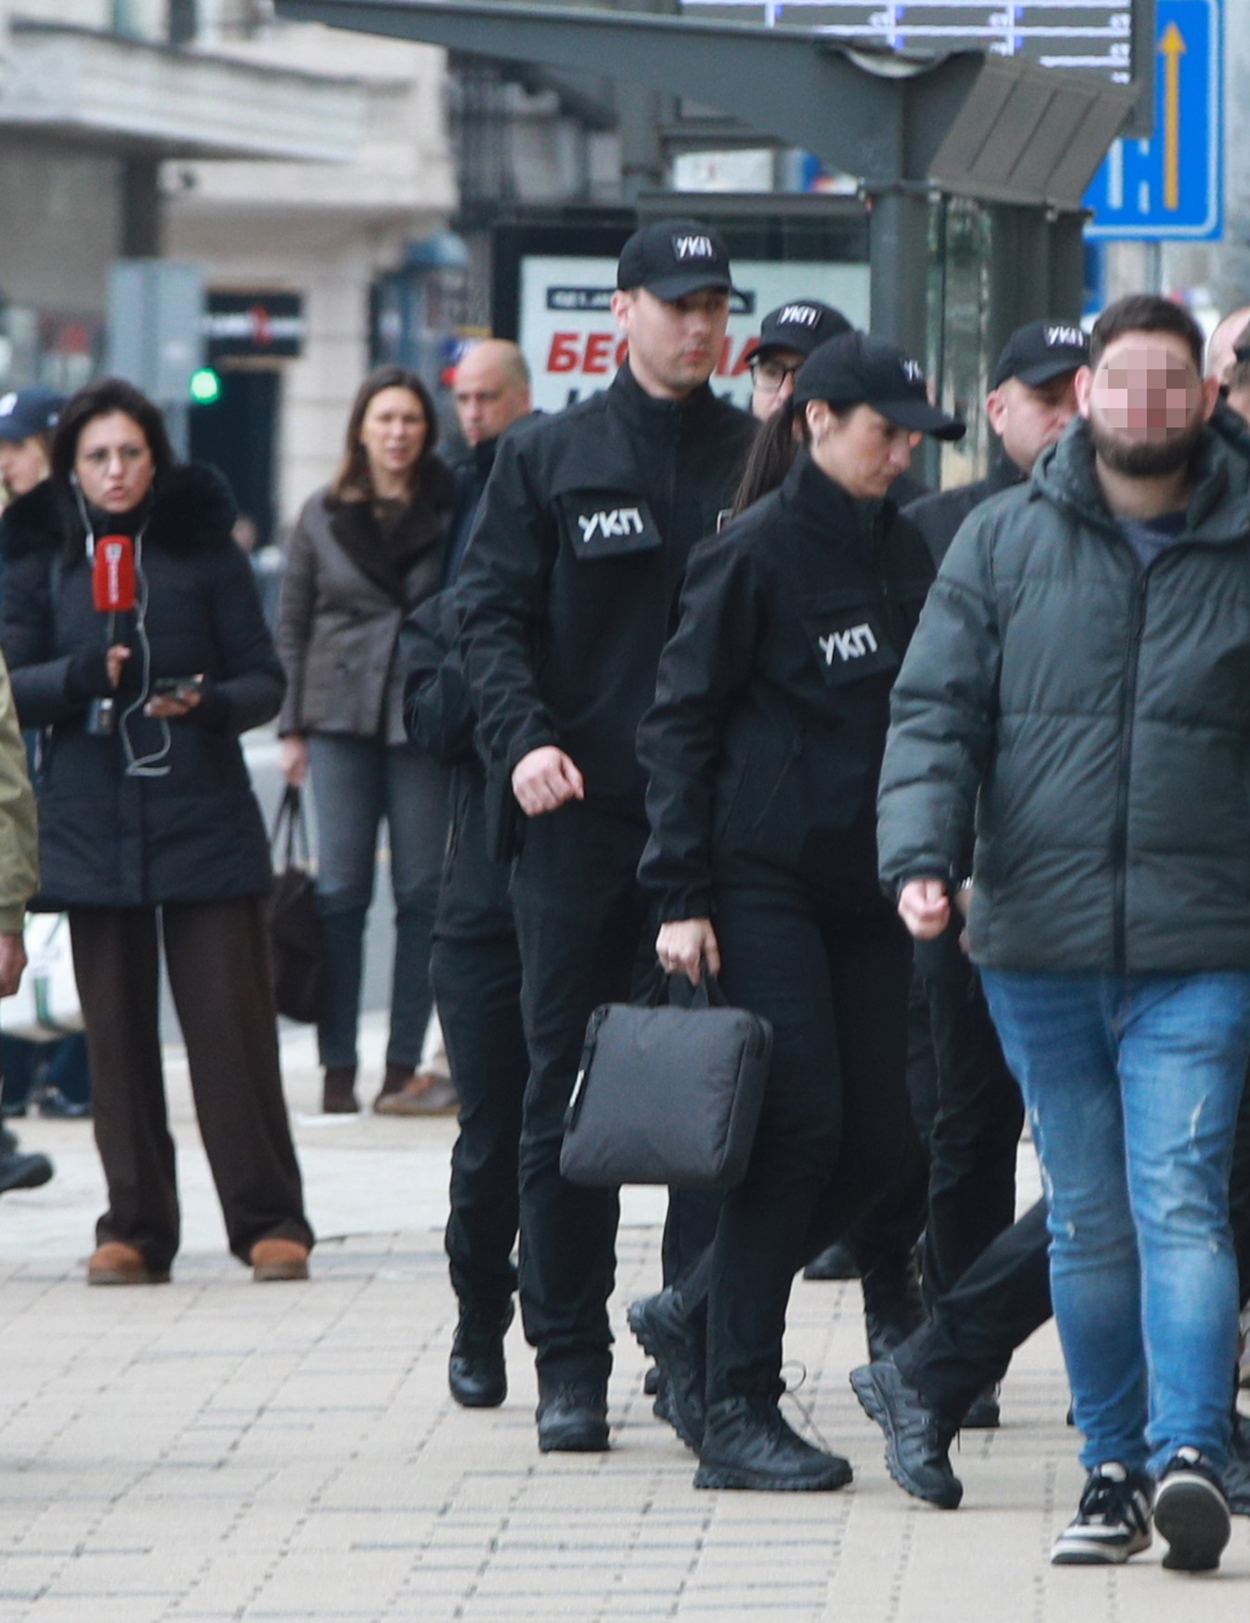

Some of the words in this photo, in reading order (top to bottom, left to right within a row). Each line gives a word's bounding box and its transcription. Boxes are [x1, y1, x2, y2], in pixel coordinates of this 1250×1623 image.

[676, 235, 713, 258] УКП
[779, 305, 817, 326] УКП
[1048, 325, 1084, 347] УКП
[578, 507, 644, 542] УКП
[819, 622, 878, 666] УКП
